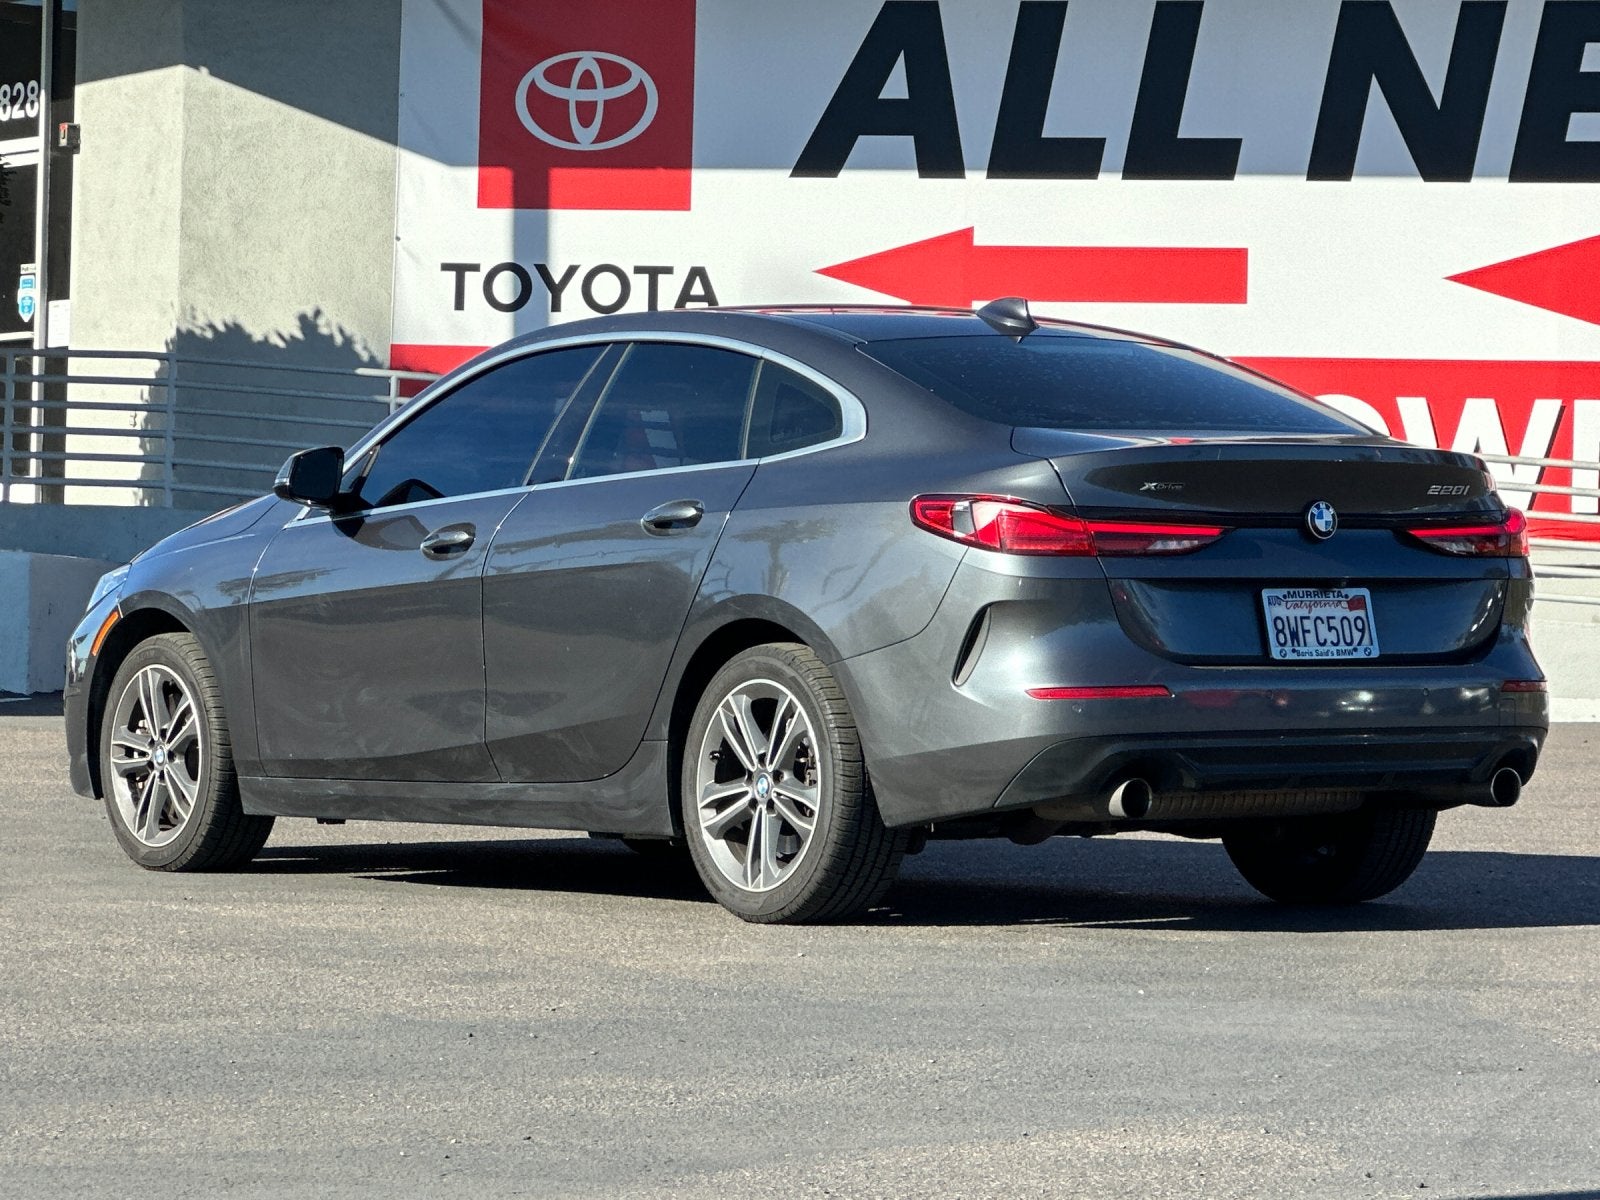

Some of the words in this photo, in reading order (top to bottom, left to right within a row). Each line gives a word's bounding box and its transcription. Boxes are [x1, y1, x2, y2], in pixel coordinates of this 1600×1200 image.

[790, 0, 1243, 180] ALL
[1306, 0, 1600, 182] NE
[440, 262, 720, 314] TOYOTA
[1287, 590, 1344, 599] MURRIETA
[1284, 600, 1344, 614] California
[1273, 615, 1366, 647] 8WFC509
[1315, 649, 1334, 657] Said's
[1336, 649, 1354, 657] BMW
